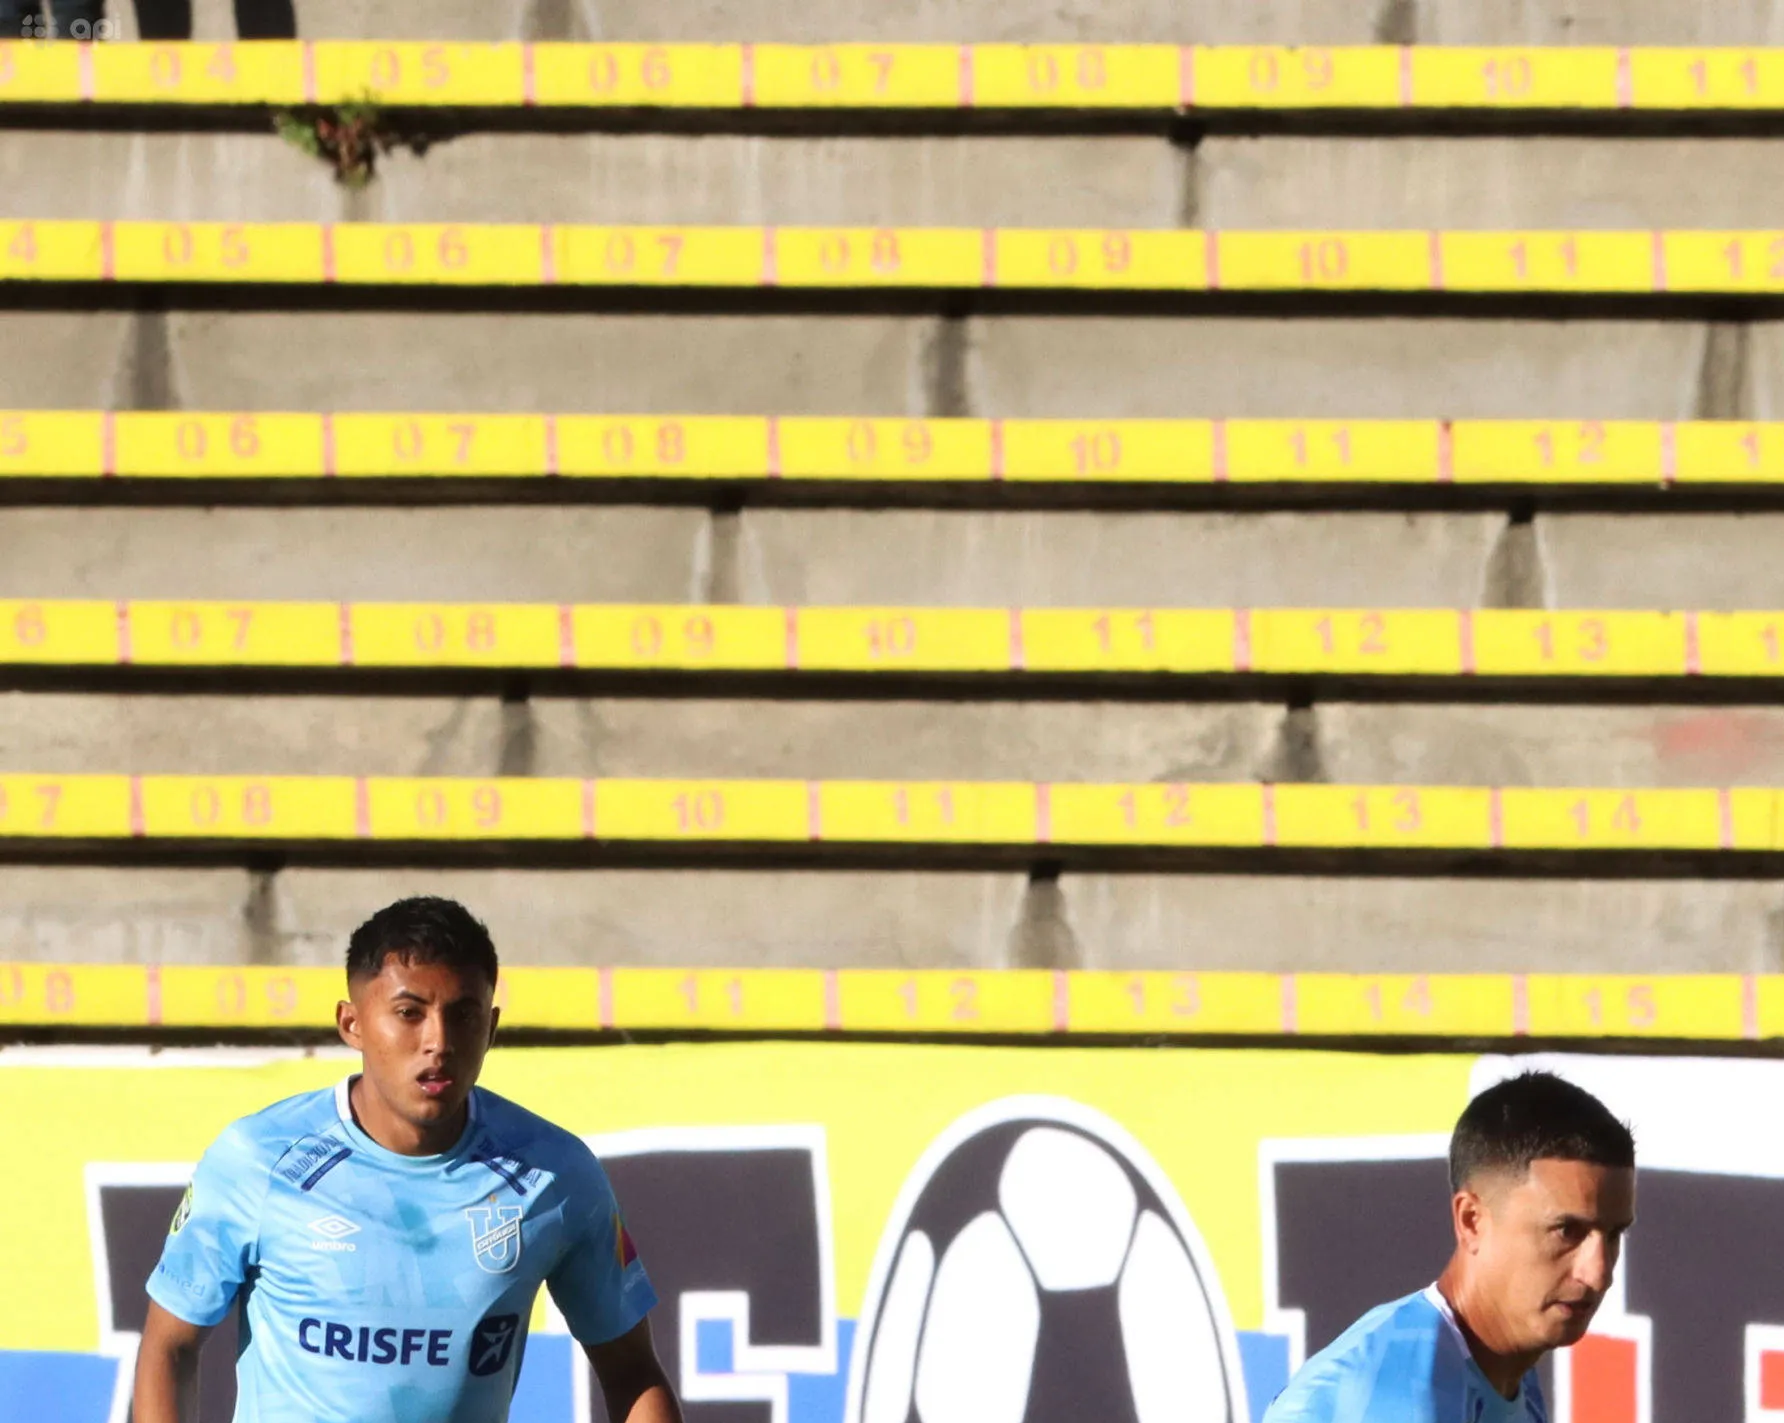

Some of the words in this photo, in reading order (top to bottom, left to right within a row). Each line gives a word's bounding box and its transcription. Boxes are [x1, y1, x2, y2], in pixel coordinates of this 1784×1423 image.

[8, 224, 39, 266] 4
[0, 416, 29, 459] 5
[13, 605, 47, 648] 6
[312, 1240, 356, 1252] umbro
[299, 1317, 453, 1367] CRISFE
